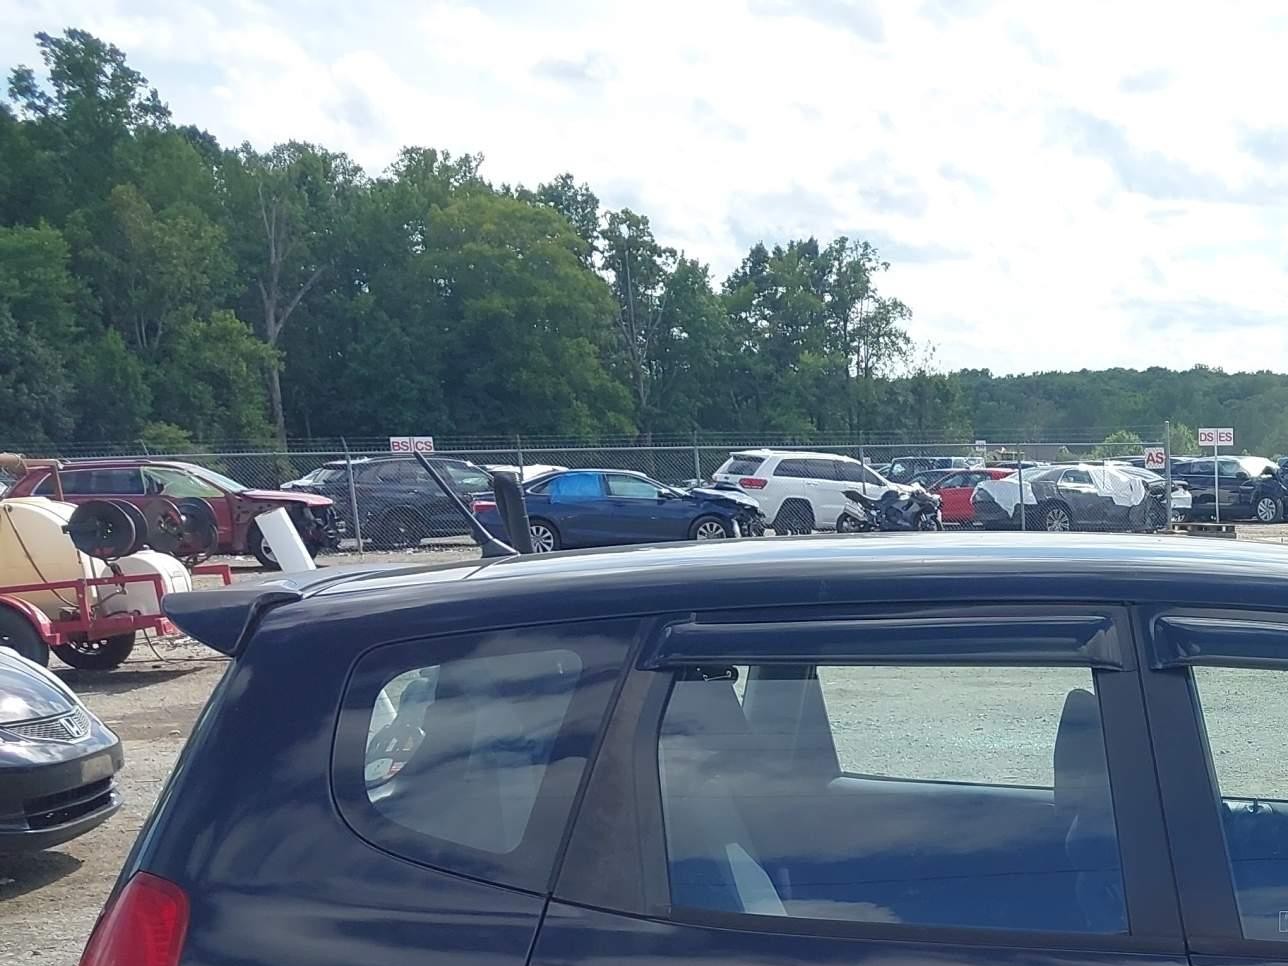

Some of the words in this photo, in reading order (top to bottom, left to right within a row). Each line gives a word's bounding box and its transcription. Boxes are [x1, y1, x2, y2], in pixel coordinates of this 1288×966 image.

[1199, 432, 1214, 442] DS
[1218, 432, 1233, 442] ES
[391, 440, 410, 451] BS
[415, 440, 433, 451] CS
[1146, 452, 1165, 464] AS
